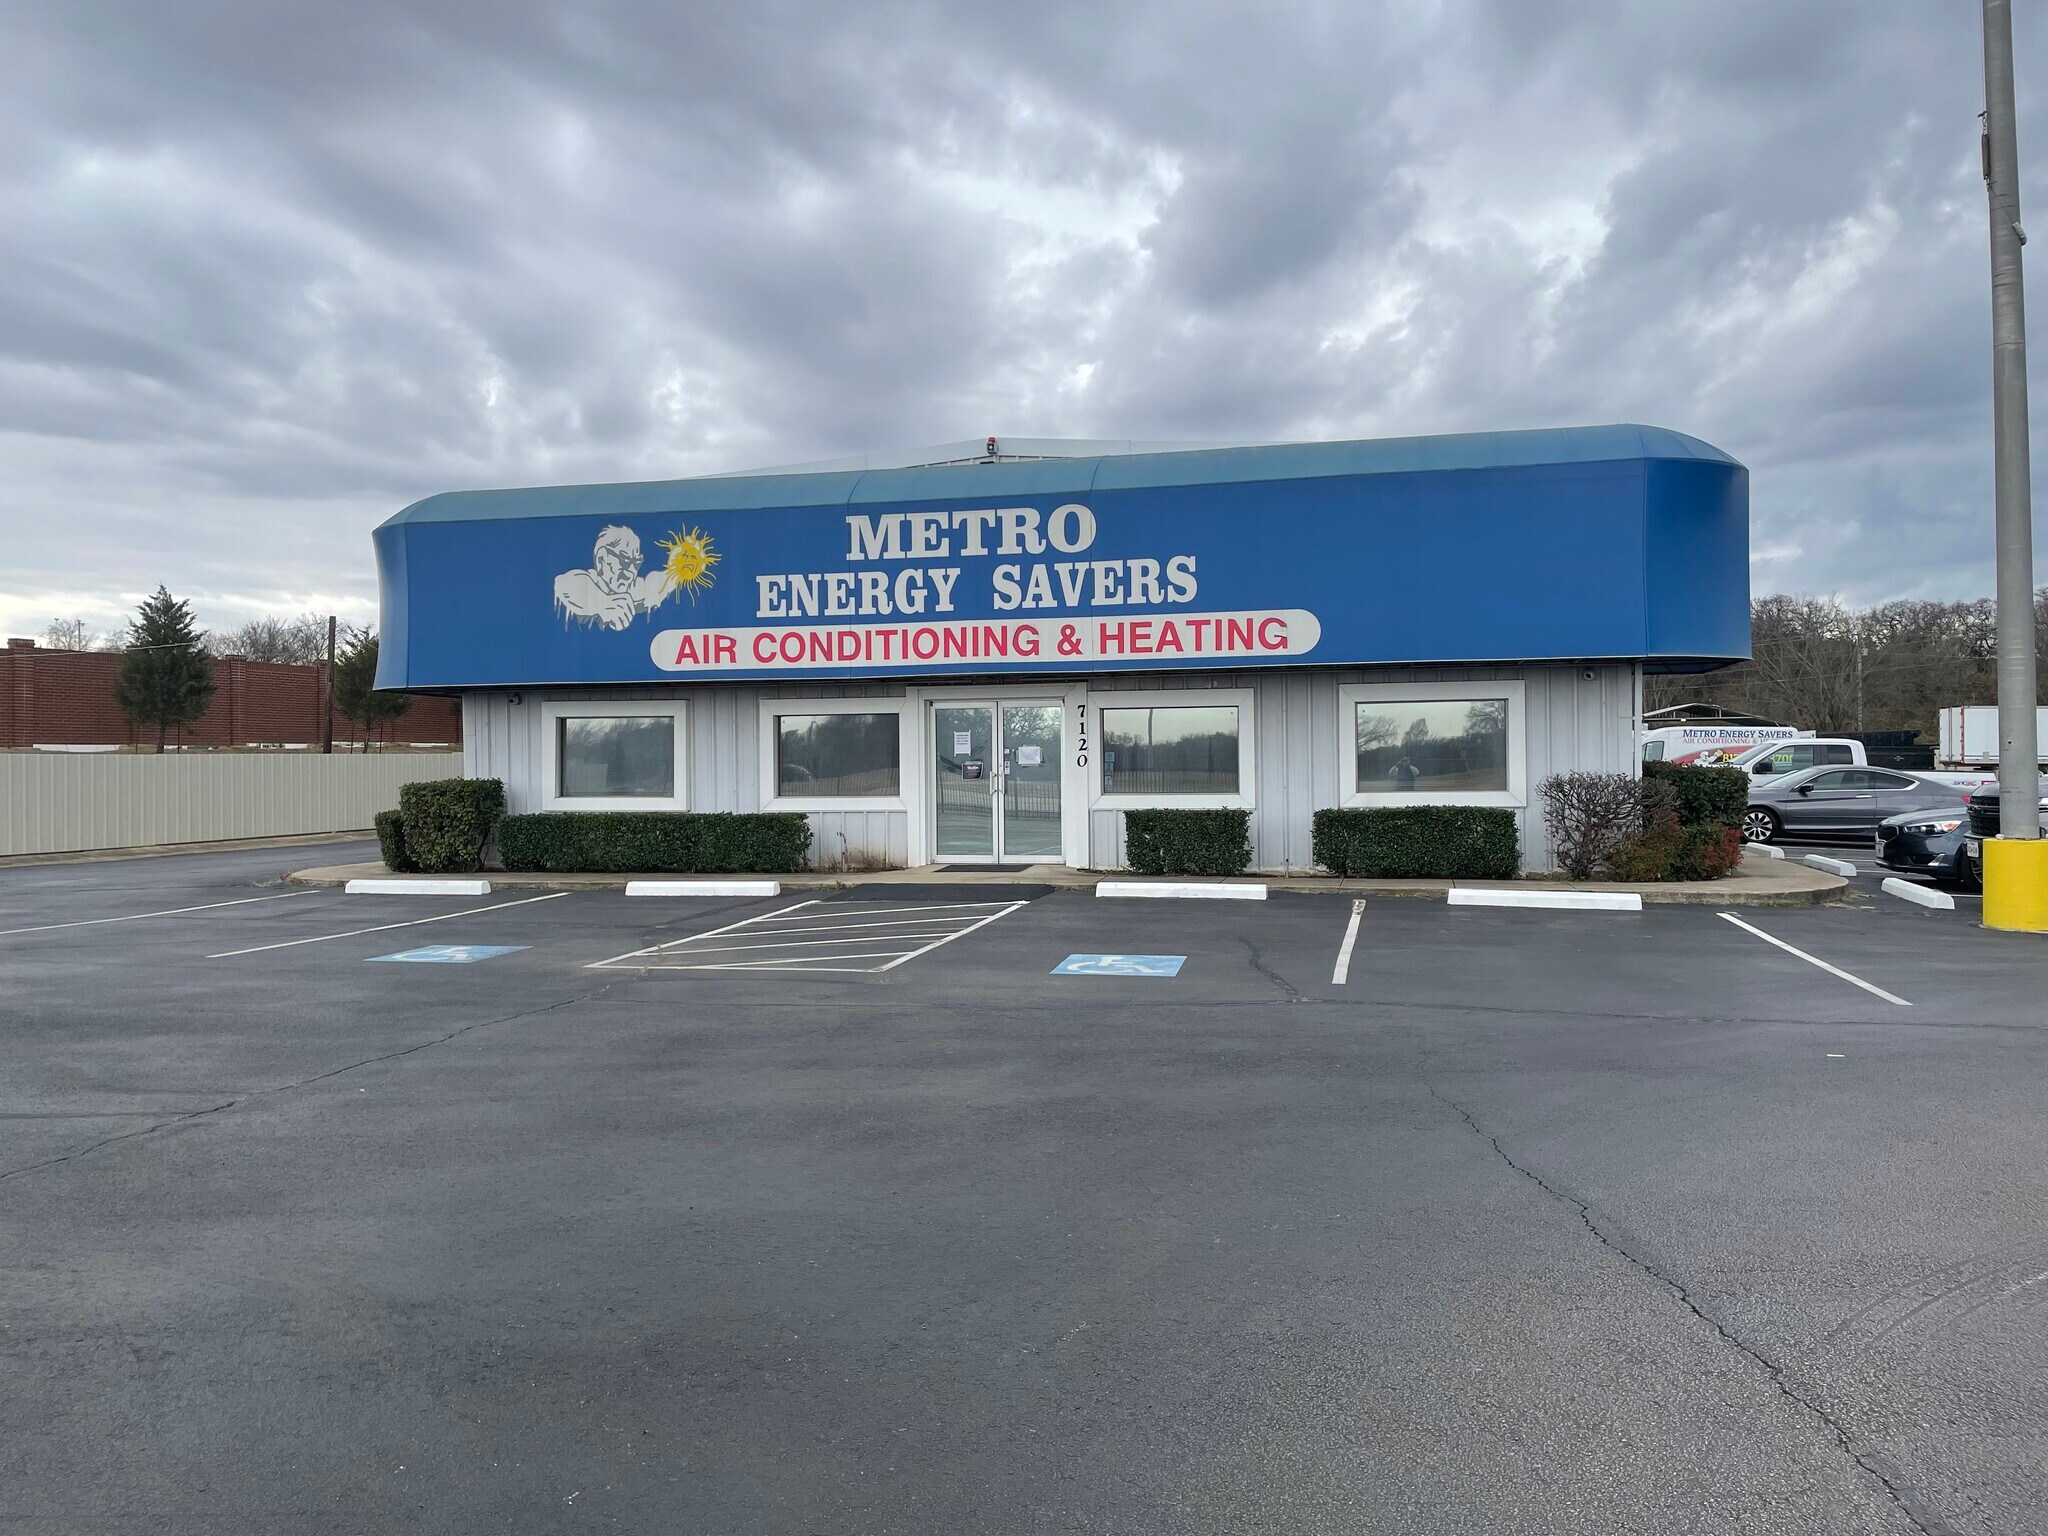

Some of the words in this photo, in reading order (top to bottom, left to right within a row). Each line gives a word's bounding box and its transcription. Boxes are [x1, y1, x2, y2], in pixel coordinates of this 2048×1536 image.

[846, 505, 1097, 560] METRO
[756, 568, 961, 618] ENERGY
[992, 556, 1198, 611] SAVERS
[676, 634, 737, 665] AIR
[753, 624, 1041, 664] CONDITIONING
[1056, 624, 1083, 656] &
[1100, 617, 1288, 654] HEATING
[1077, 705, 1088, 767] 7120
[1682, 729, 1717, 739] METRO
[1720, 729, 1756, 739] ENERGY
[1758, 730, 1794, 739] SAVERS
